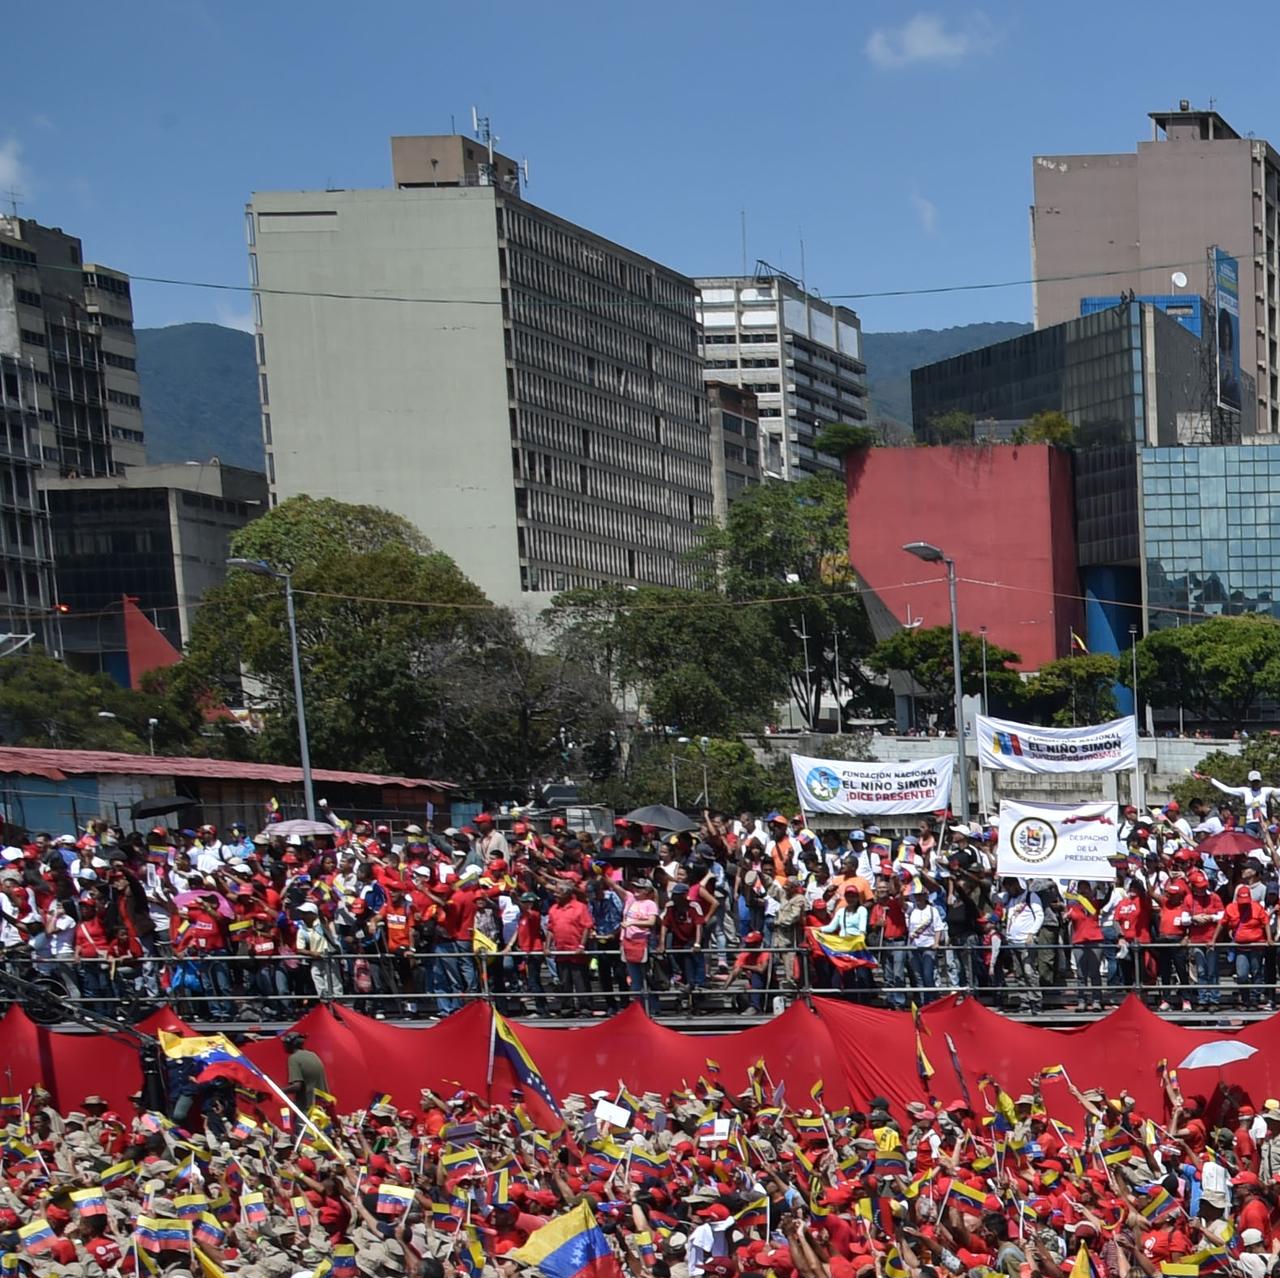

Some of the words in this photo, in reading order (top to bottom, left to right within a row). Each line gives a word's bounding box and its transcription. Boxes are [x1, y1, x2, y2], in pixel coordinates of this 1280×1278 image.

[1029, 743, 1043, 752] EL
[1046, 742, 1078, 753] NIÑO
[842, 769, 892, 779] FUNDACIÓN
[894, 768, 937, 779] NACIONAL
[842, 779, 857, 790] EL
[861, 779, 893, 791] NIÑO
[897, 776, 938, 791] SIMÓN
[875, 789, 935, 801] PRESENTE!
